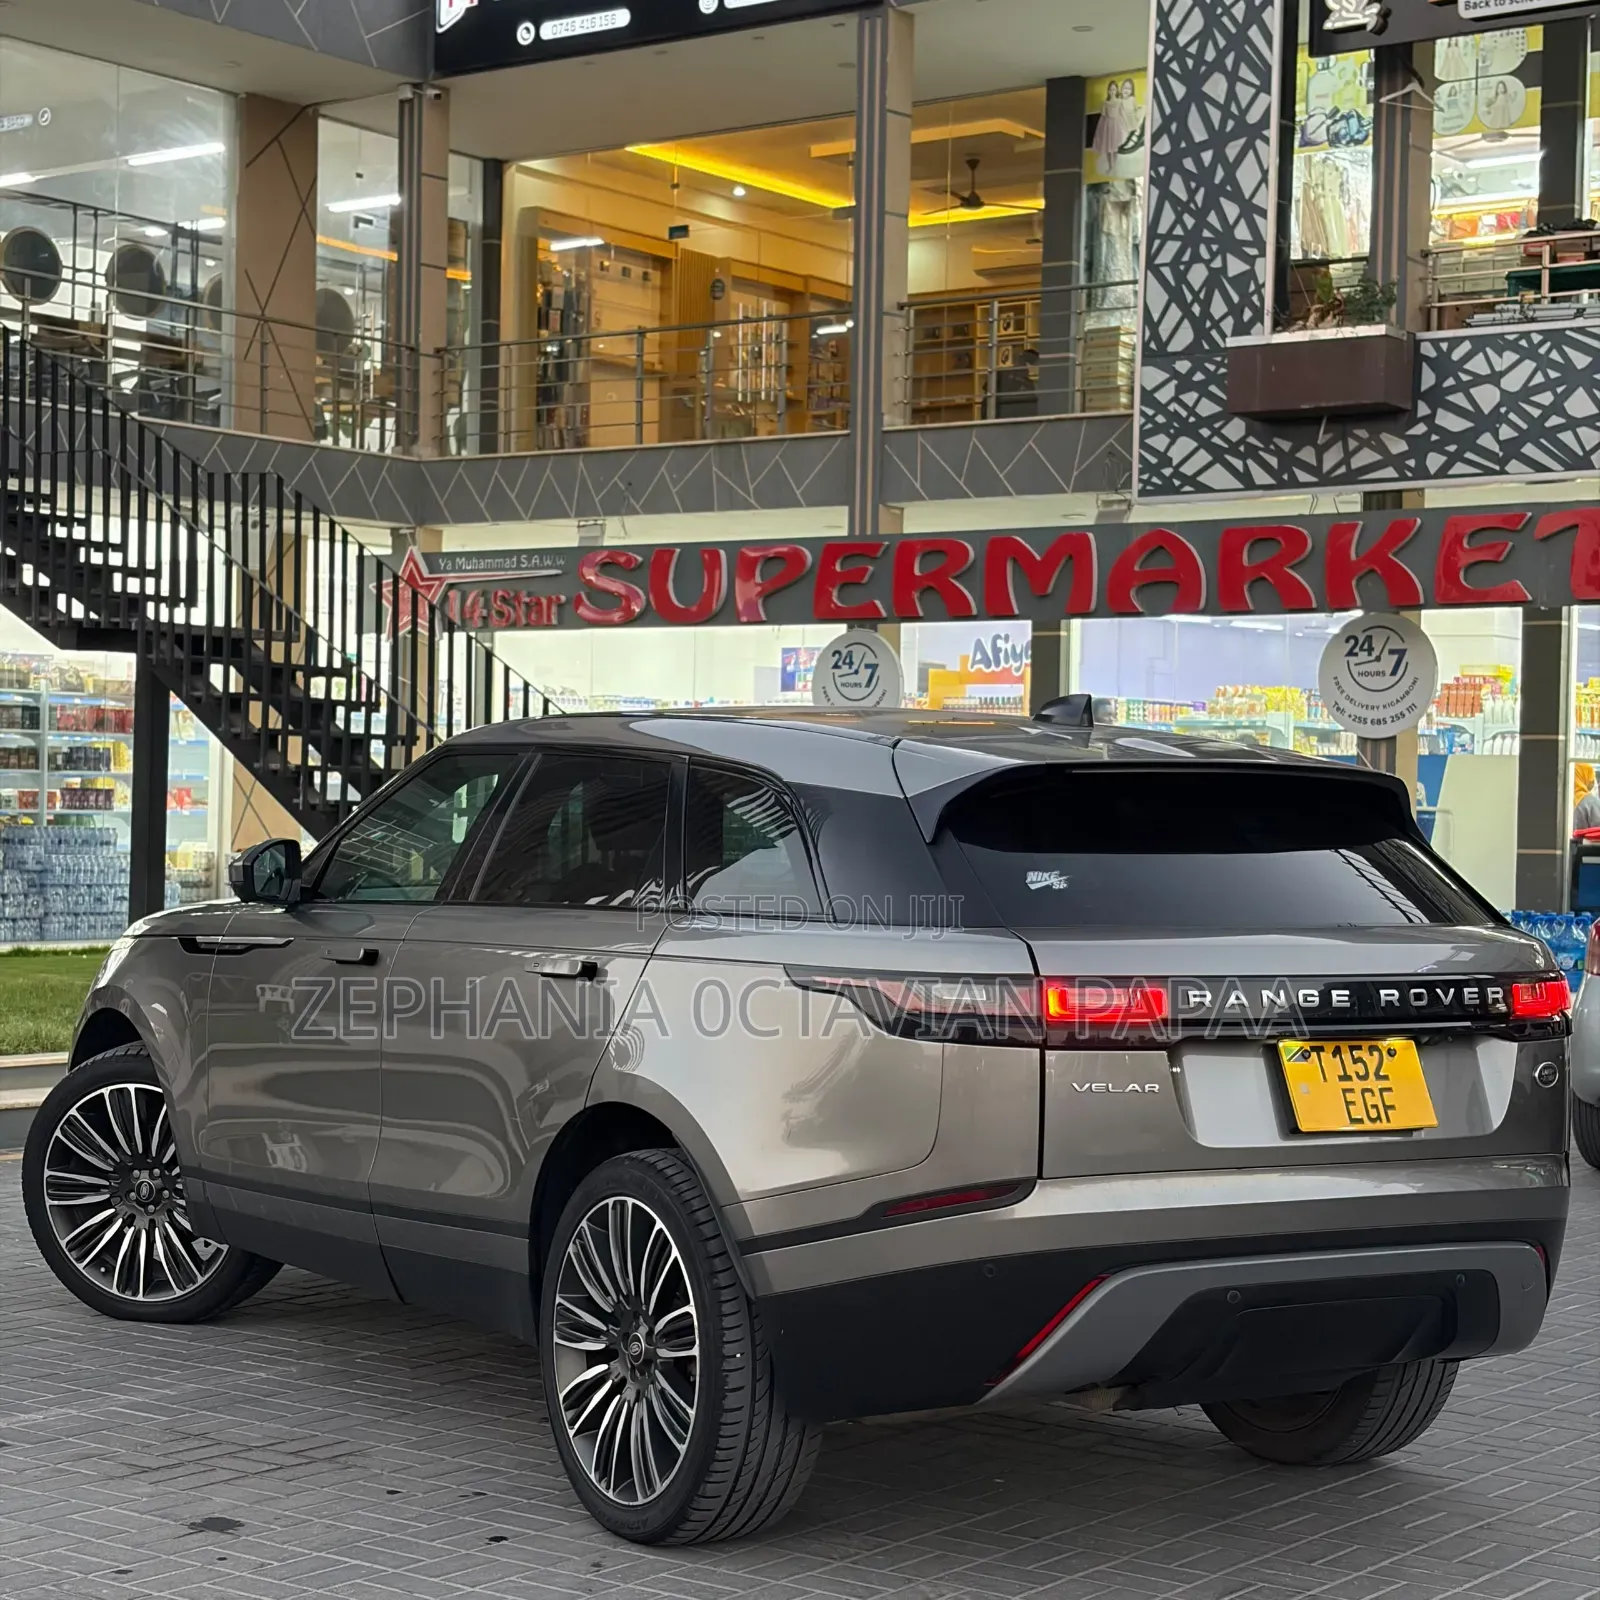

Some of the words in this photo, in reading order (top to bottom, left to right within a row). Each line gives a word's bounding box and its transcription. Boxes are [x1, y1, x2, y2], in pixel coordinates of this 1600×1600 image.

[1464, 0, 1491, 11] Back
[439, 557, 453, 571] Ya
[455, 555, 517, 570] Muhammad
[573, 508, 1600, 626] SUPERMARKET
[447, 589, 487, 628] 14
[489, 588, 566, 628] Star
[1357, 670, 1386, 678] HOURS
[1332, 675, 1346, 696] FREE
[1344, 694, 1380, 711] DELIVERY
[1382, 676, 1419, 711] KIGAMBONI
[1331, 700, 1347, 717] Tel:
[1347, 712, 1368, 726] +255
[1370, 717, 1388, 726] 685
[1389, 712, 1406, 724] 255
[1405, 702, 1418, 715] 111
[1026, 870, 1060, 882] NIKE
[1187, 989, 1351, 1008] RANGE
[1379, 987, 1506, 1007] ROVER
[1071, 1082, 1160, 1094] VELAR
[1341, 1086, 1397, 1125] EGF
